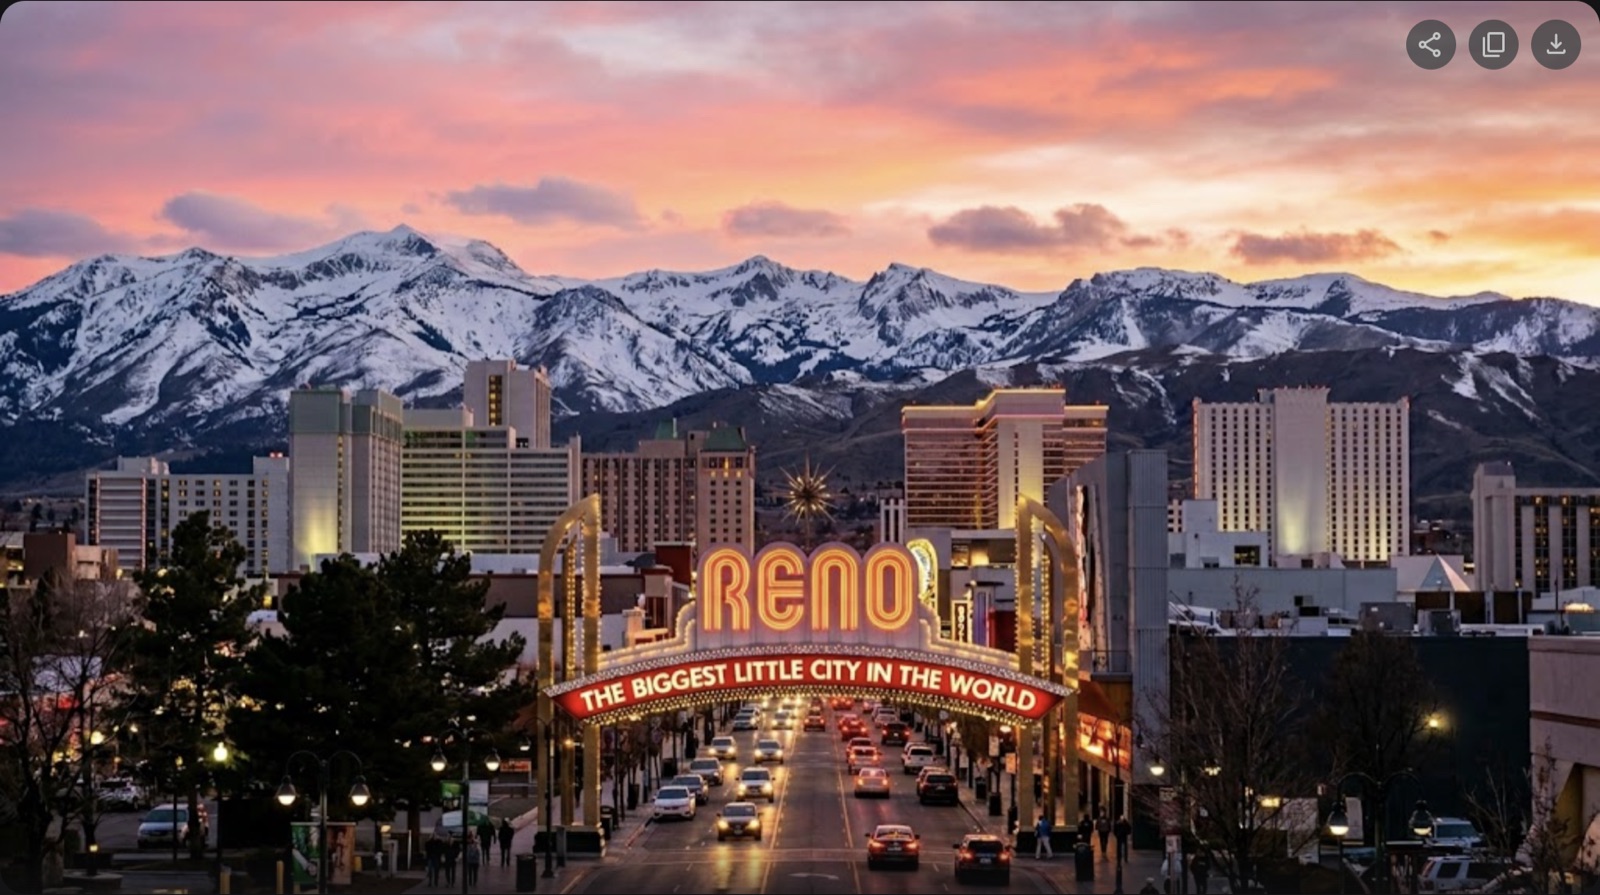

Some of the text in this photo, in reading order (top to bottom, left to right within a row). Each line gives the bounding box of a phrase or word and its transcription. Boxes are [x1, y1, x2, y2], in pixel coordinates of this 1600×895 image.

[704, 549, 913, 631] RENO
[580, 659, 1036, 711] THE BIGGEST LITTLE CITY IN THE WORLD
